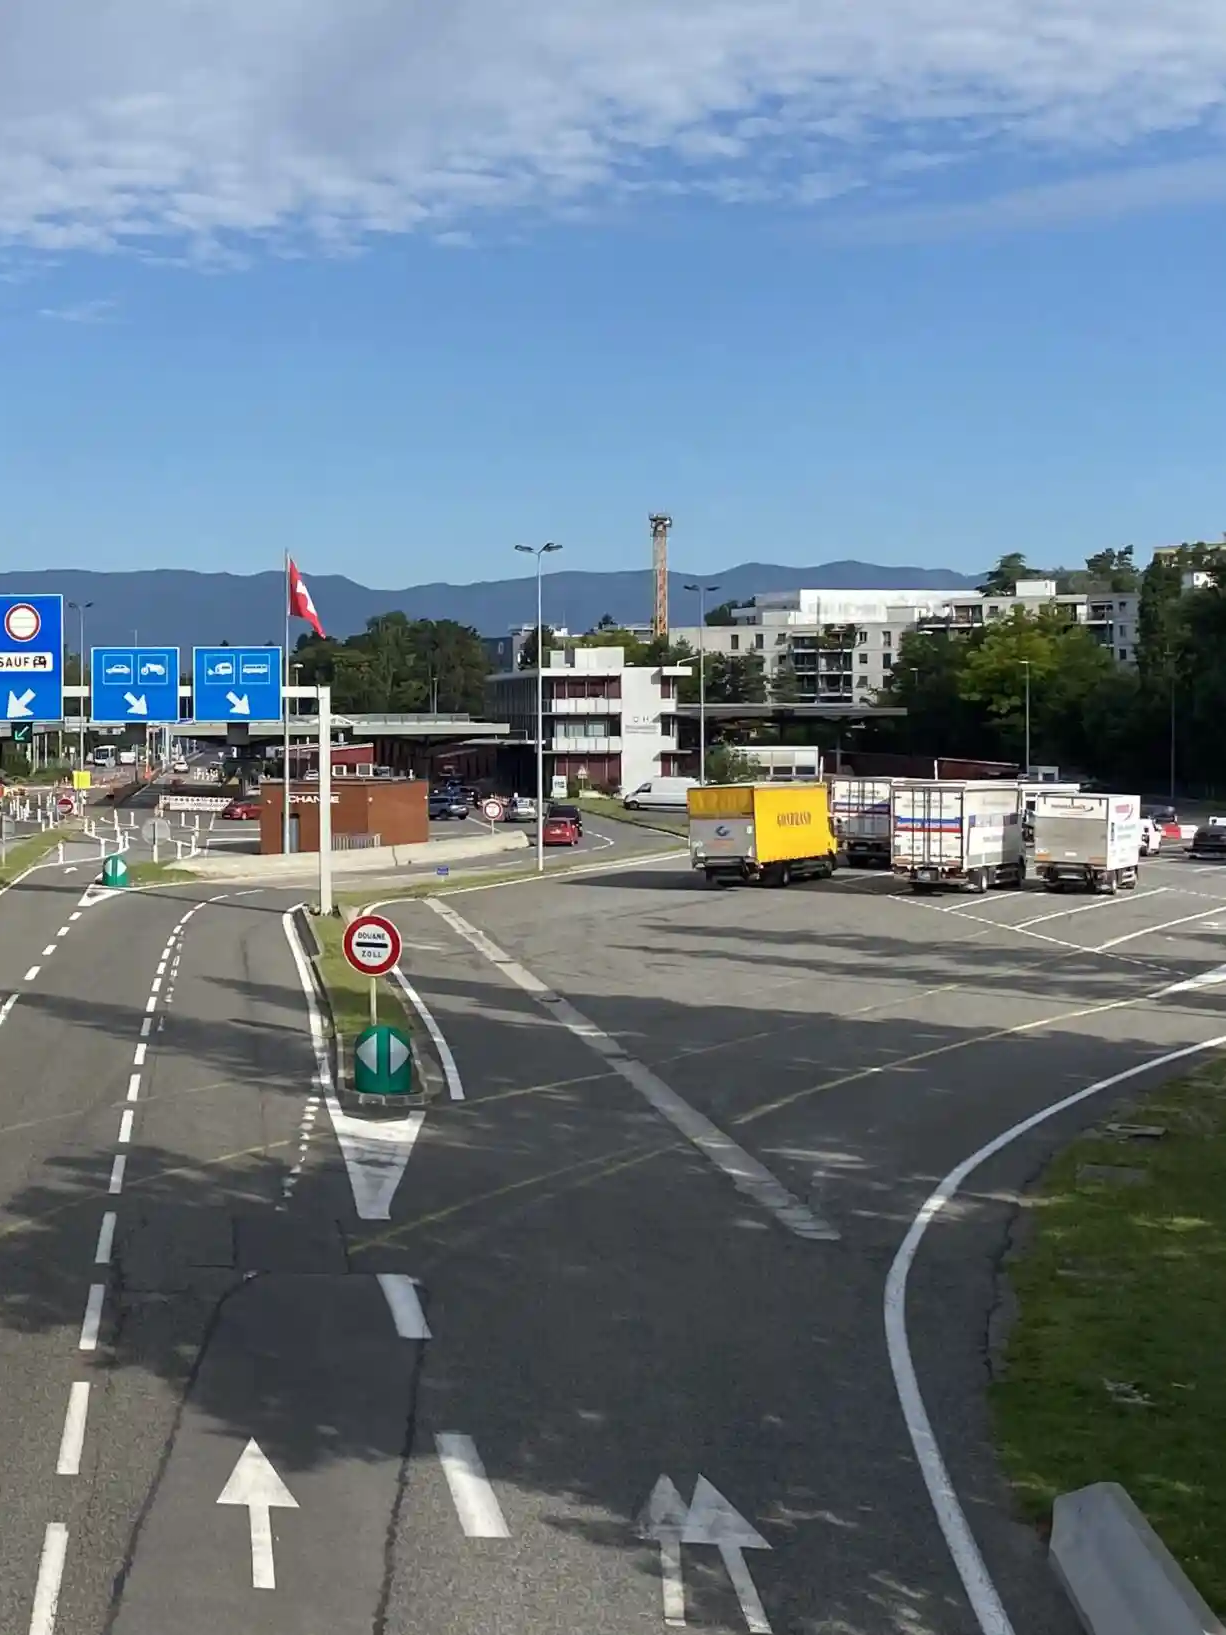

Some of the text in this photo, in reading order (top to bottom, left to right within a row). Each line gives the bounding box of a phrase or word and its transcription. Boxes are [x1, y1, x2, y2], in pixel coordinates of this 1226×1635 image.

[288, 795, 341, 804] CHANE
[357, 931, 386, 941] DOUANE
[361, 950, 382, 958] ZOLL
